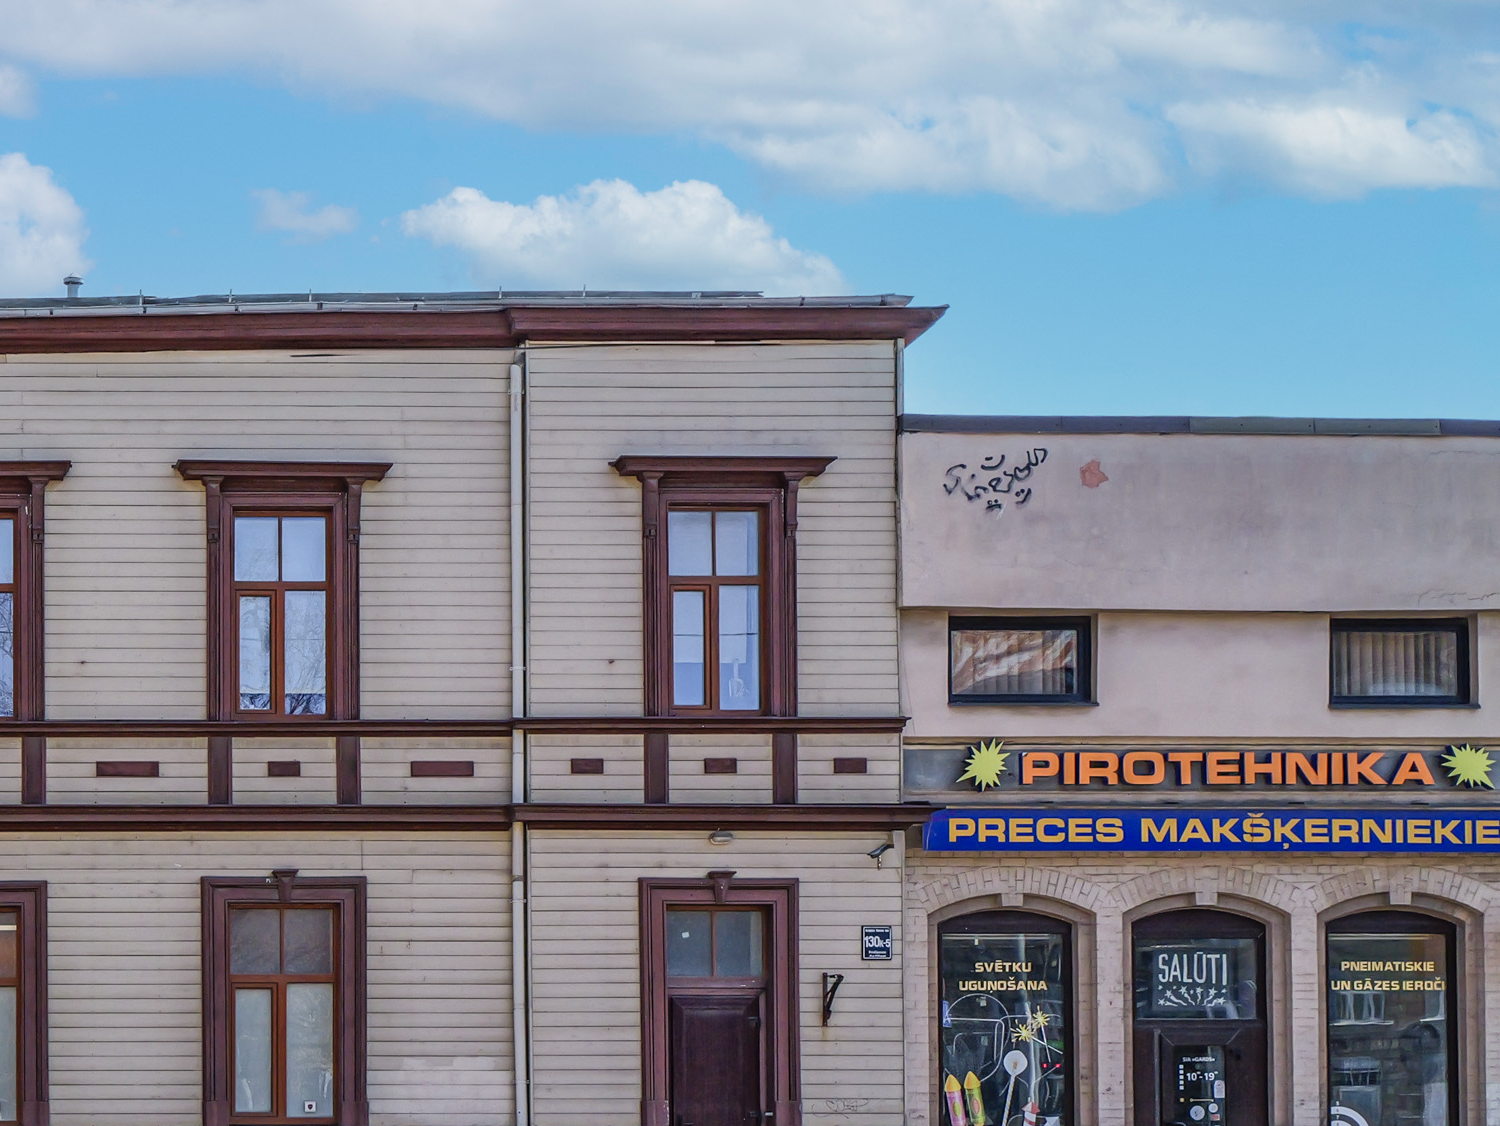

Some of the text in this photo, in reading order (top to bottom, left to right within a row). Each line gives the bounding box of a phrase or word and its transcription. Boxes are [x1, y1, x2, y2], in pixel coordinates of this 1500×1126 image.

[1020, 751, 1436, 785] PIROTEHNIKA
[948, 817, 1125, 843] PRECES
[975, 960, 1032, 973] SVĒTKU
[1158, 951, 1228, 986] SALŪTI
[1341, 961, 1435, 972] PNEIMATISKIE
[959, 976, 1048, 993] UGUŅOŠANA
[1331, 976, 1446, 991] UN GĀZES IEROČI
